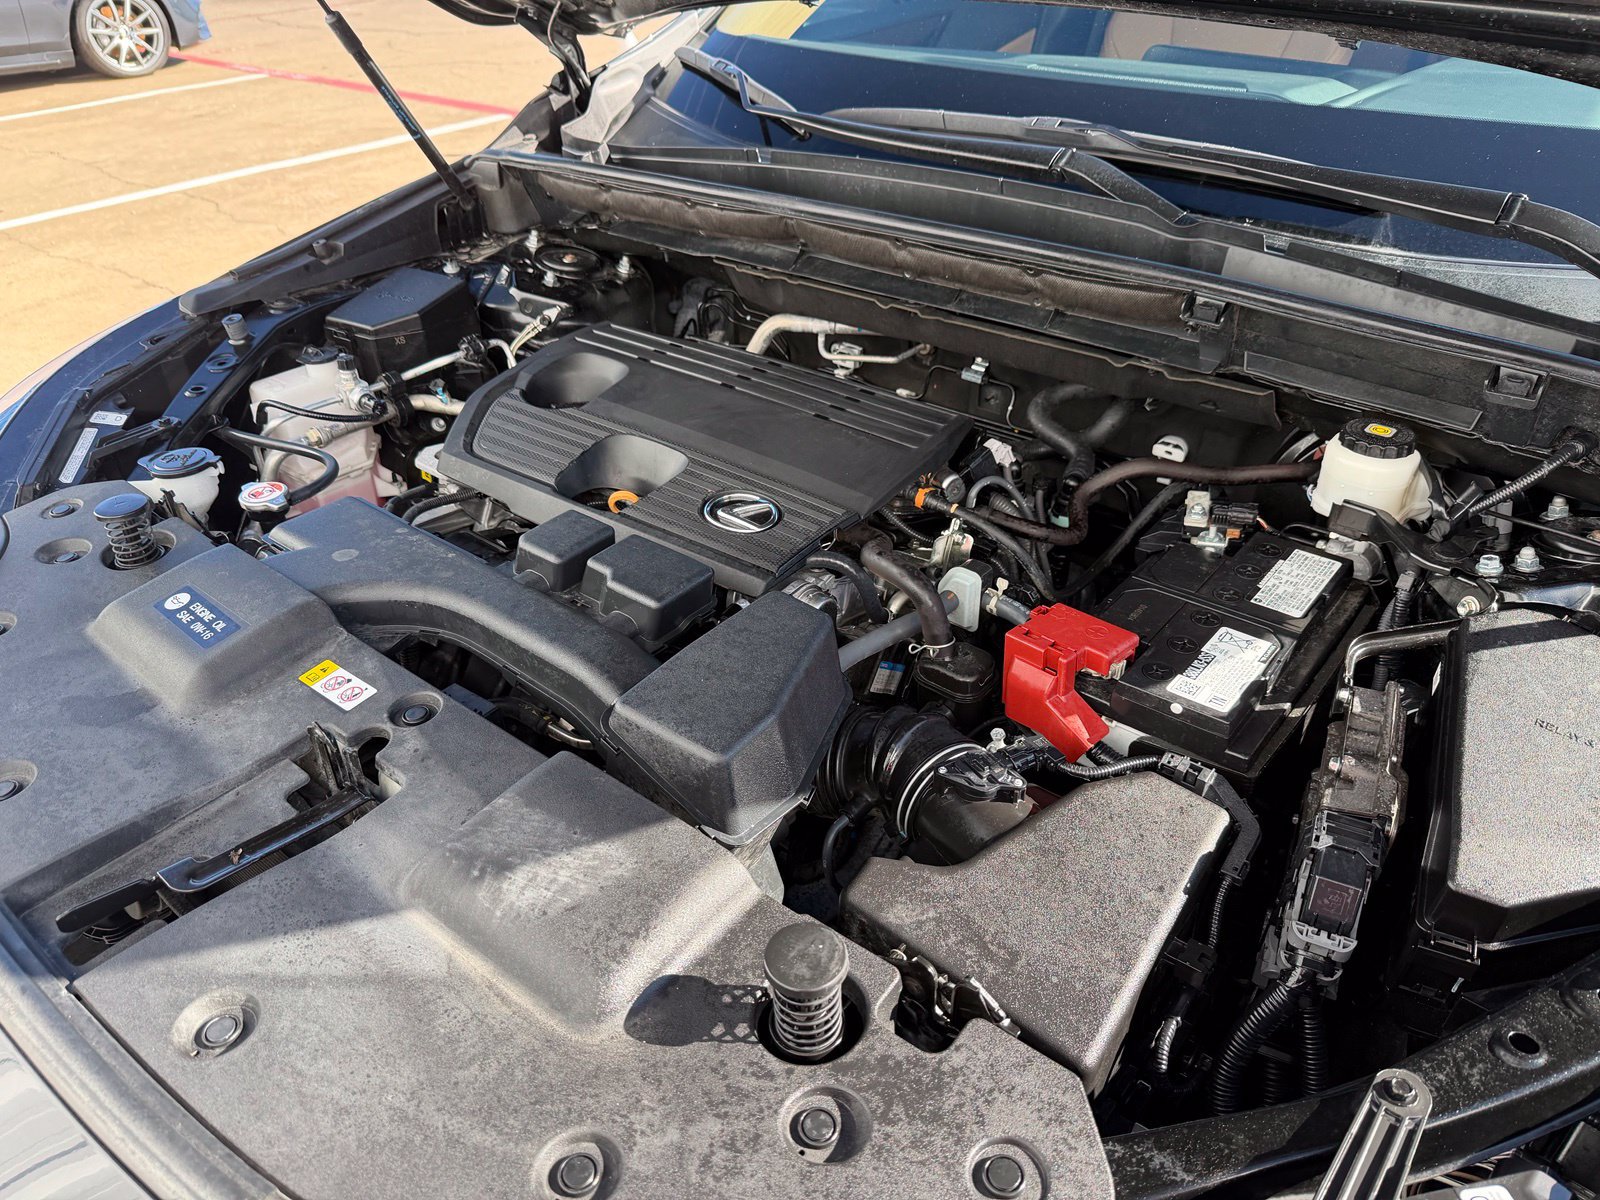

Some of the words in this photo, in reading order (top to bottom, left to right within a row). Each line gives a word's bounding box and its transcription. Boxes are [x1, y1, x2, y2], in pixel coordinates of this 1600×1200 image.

[176, 610, 195, 624] SAE
[190, 621, 214, 640] 0W-16
[189, 602, 216, 622] ENGINE
[212, 620, 226, 632] OIL
